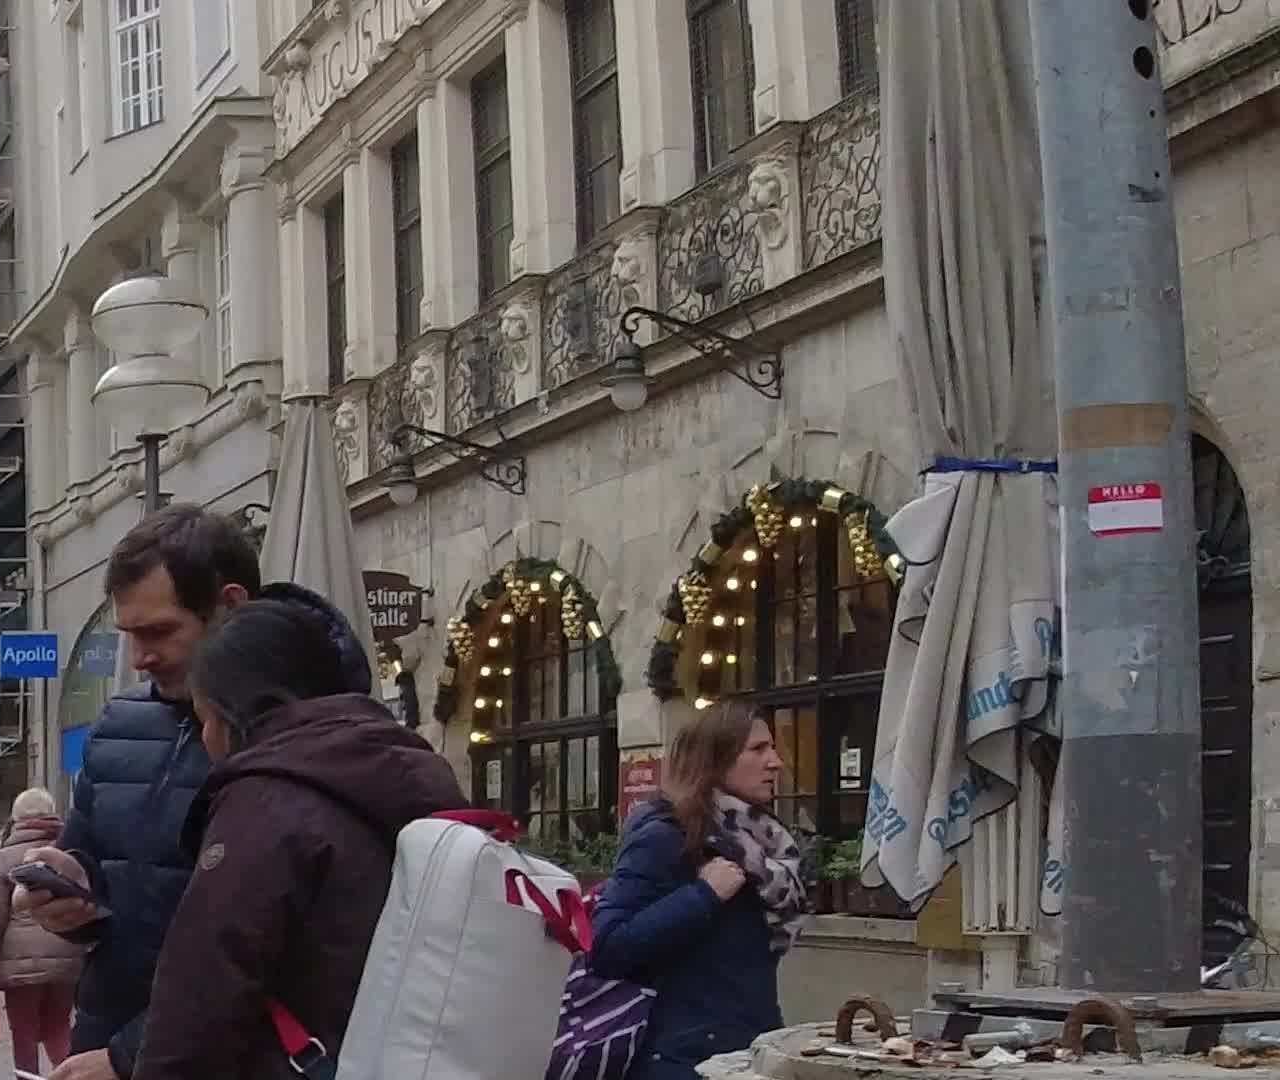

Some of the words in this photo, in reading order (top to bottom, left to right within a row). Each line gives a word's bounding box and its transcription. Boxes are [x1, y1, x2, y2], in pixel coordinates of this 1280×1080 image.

[1101, 484, 1145, 497] HELLO
[367, 587, 417, 607] stiner
[368, 607, 409, 627] halle
[2, 645, 57, 666] Apollo
